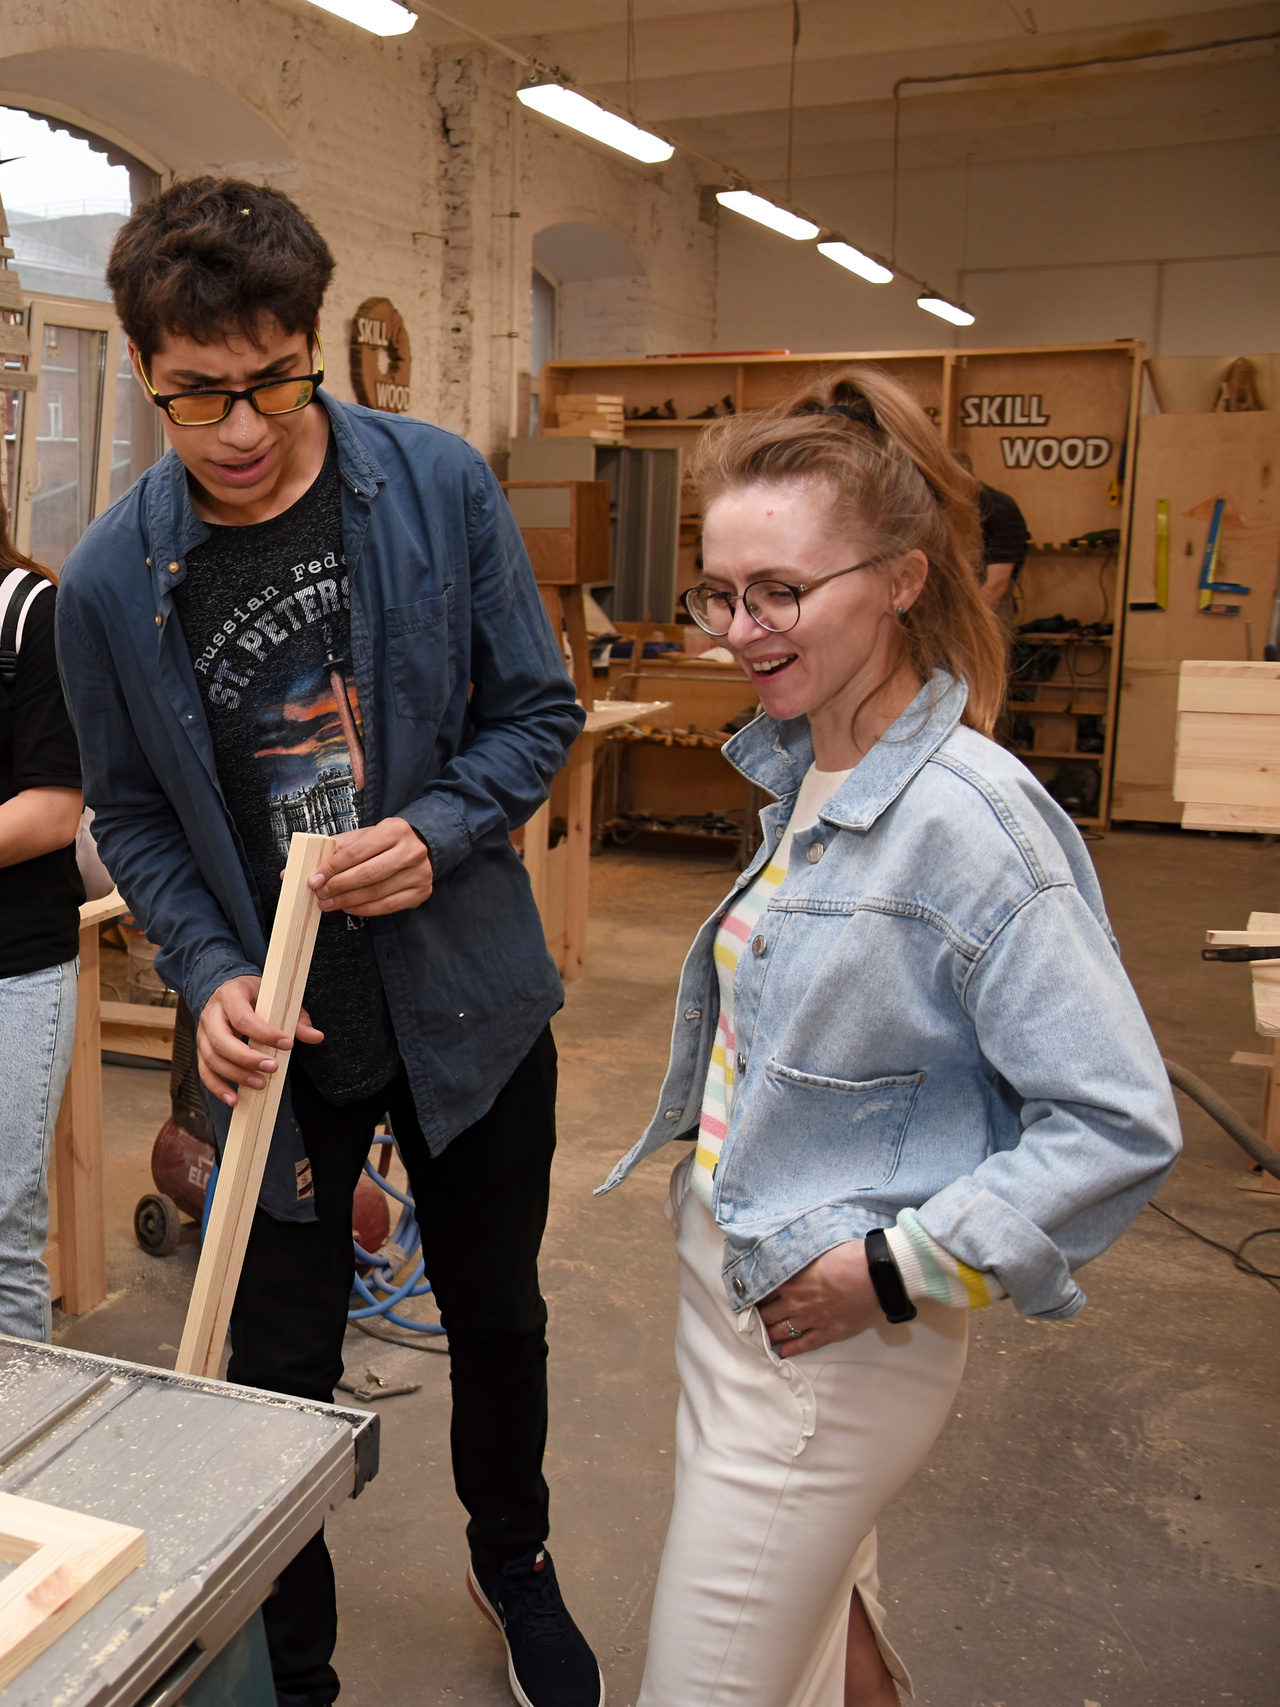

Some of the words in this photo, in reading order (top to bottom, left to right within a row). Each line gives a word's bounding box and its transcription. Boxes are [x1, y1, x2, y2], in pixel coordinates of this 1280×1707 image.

[358, 318, 389, 346] SKILL
[376, 382, 411, 412] WOOD
[962, 395, 1049, 426] SKILL
[1001, 437, 1112, 469] WOOD
[194, 585, 280, 675] Russian
[207, 658, 255, 709] ST.
